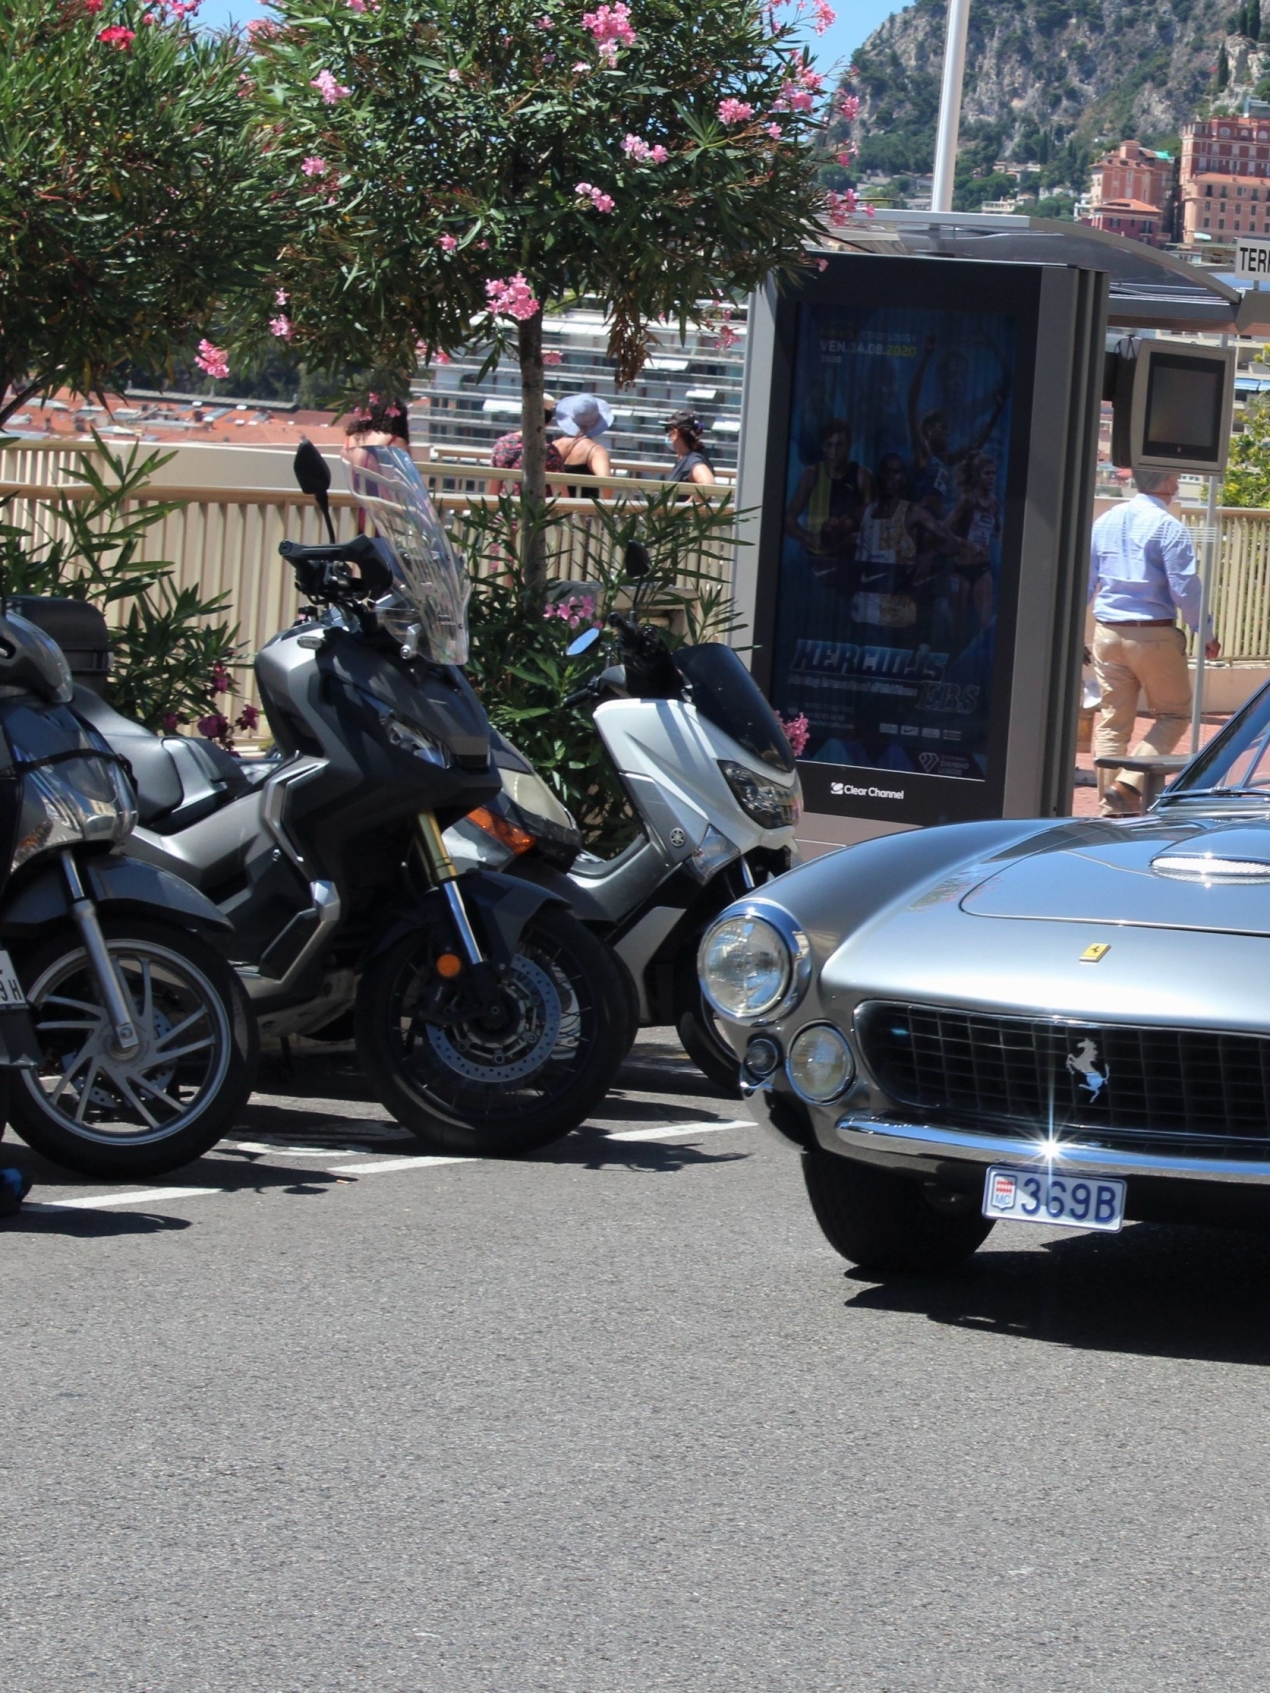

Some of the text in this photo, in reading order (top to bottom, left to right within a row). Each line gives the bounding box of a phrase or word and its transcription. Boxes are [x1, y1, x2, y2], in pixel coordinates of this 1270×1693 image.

[914, 681, 980, 715] EBS
[844, 784, 904, 799] Clear Channel
[1021, 1177, 1116, 1223] 369B
